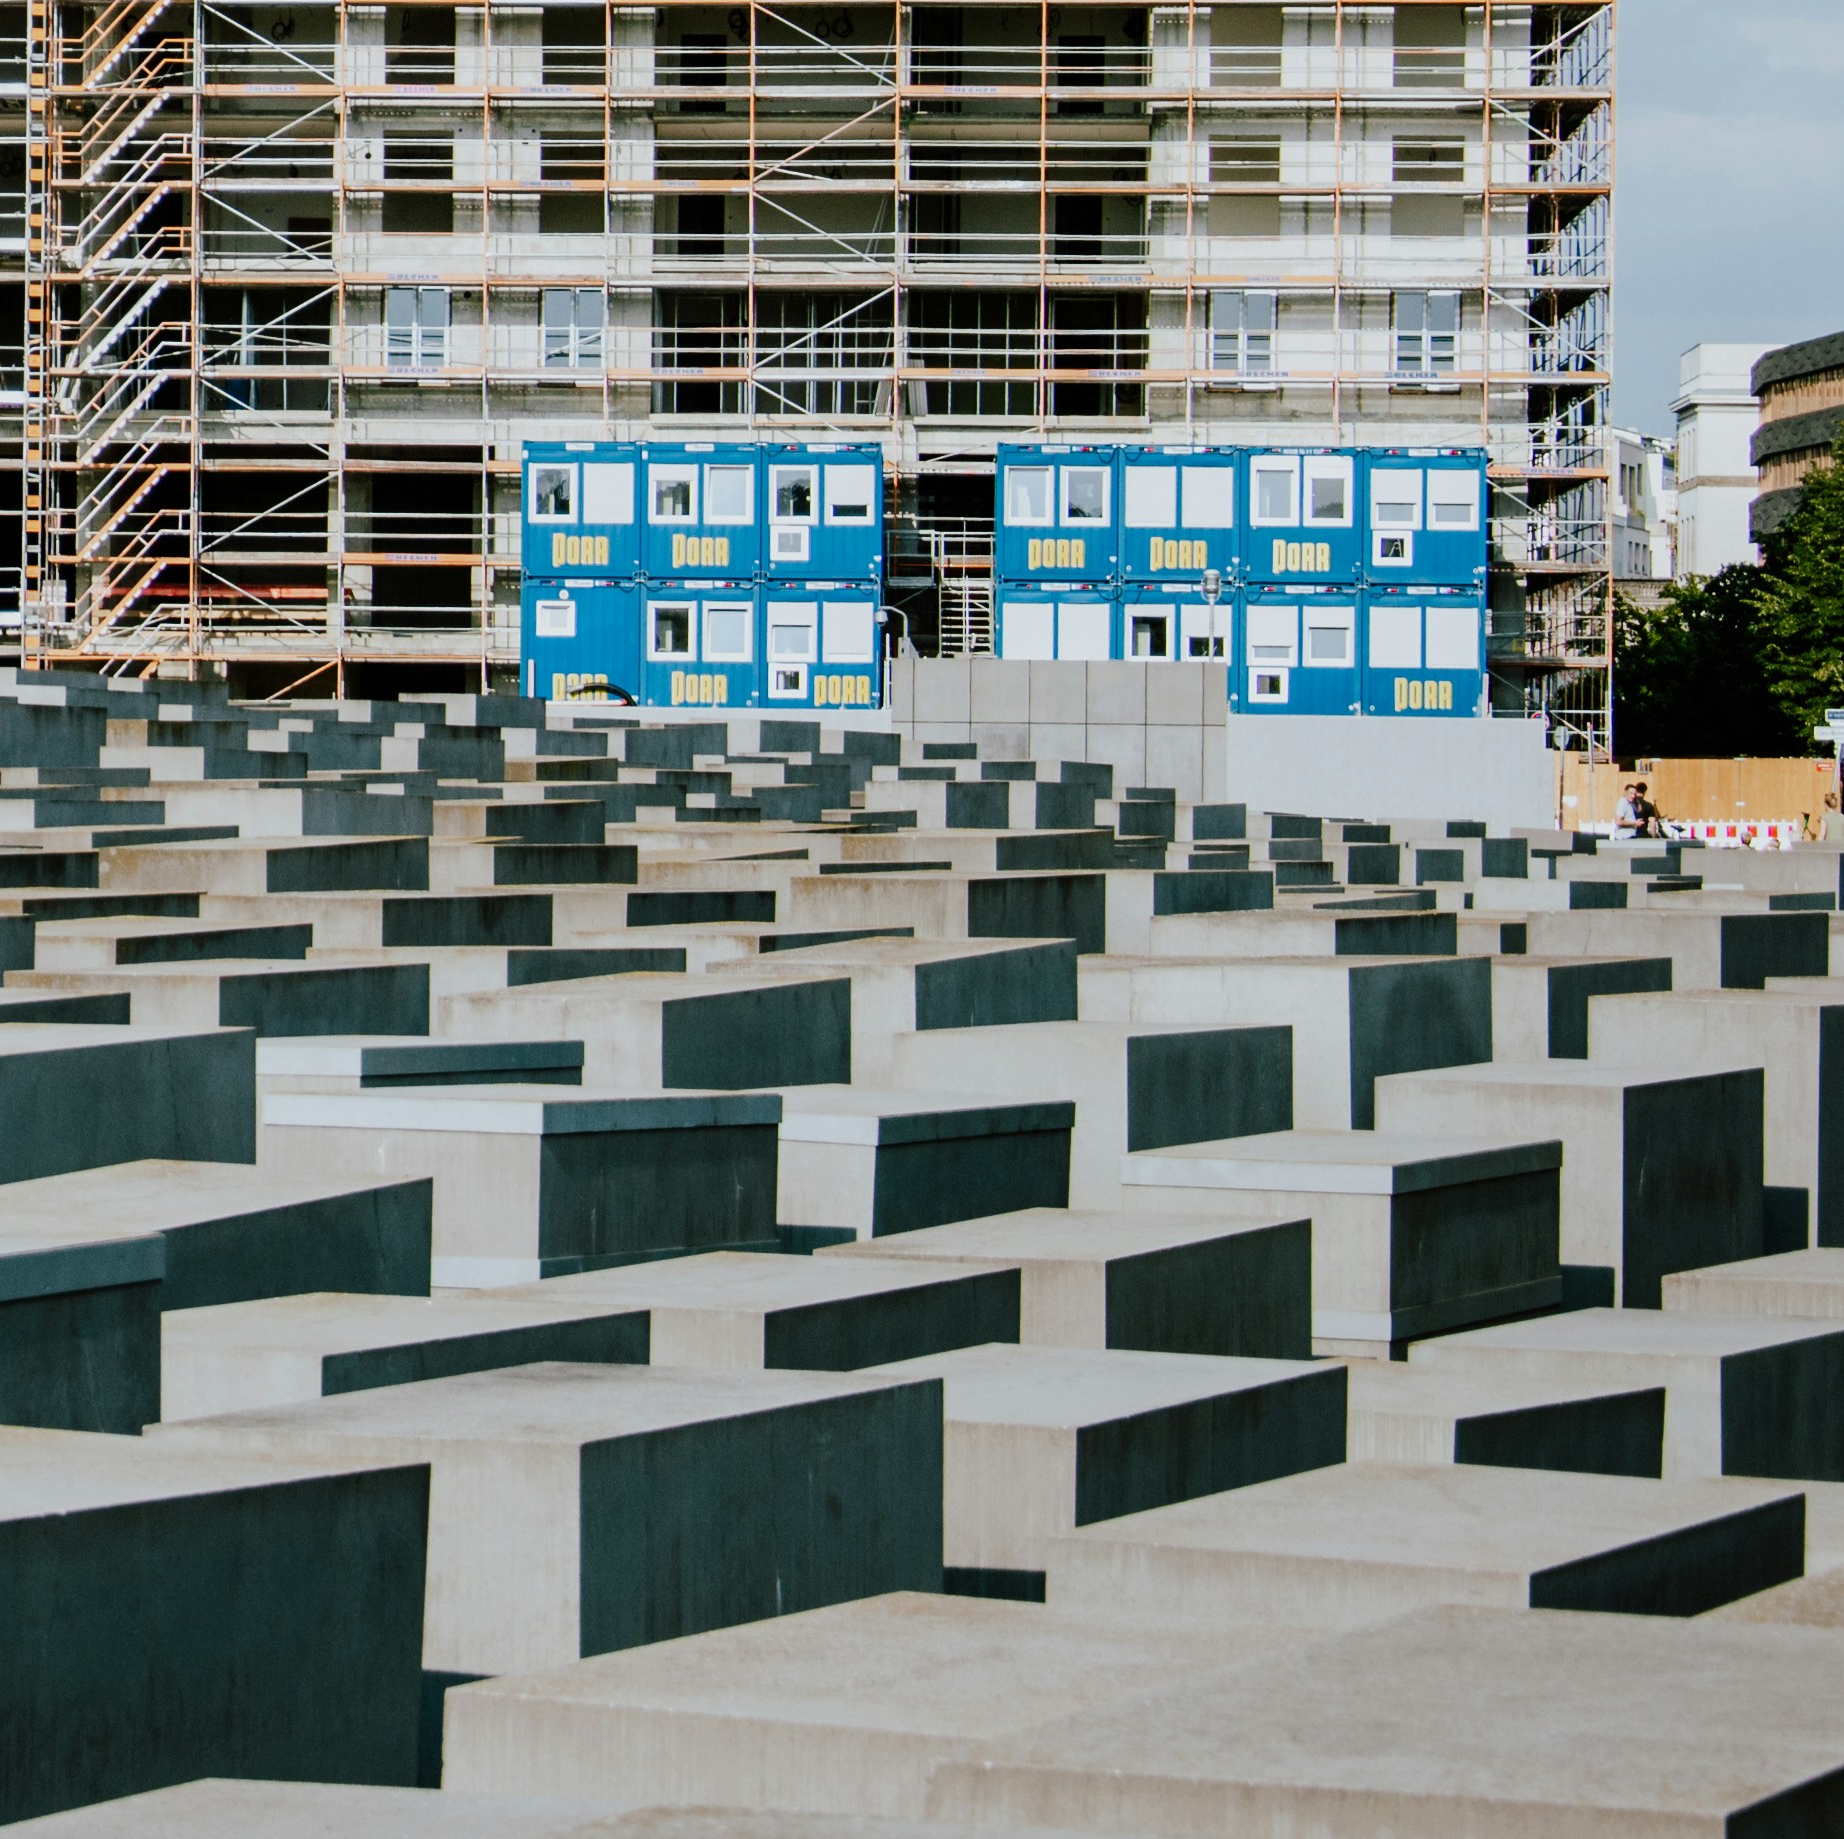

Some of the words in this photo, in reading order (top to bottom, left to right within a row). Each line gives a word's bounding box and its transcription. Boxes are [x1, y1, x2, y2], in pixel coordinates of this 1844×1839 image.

[552, 533, 609, 567] PORR
[671, 533, 730, 568] PORR
[1028, 539, 1085, 570] PORR
[1150, 537, 1207, 571] PORR
[1273, 539, 1330, 573] PORR
[671, 671, 728, 705] PORR
[814, 675, 871, 707] PORR
[1394, 677, 1452, 711] PORR
